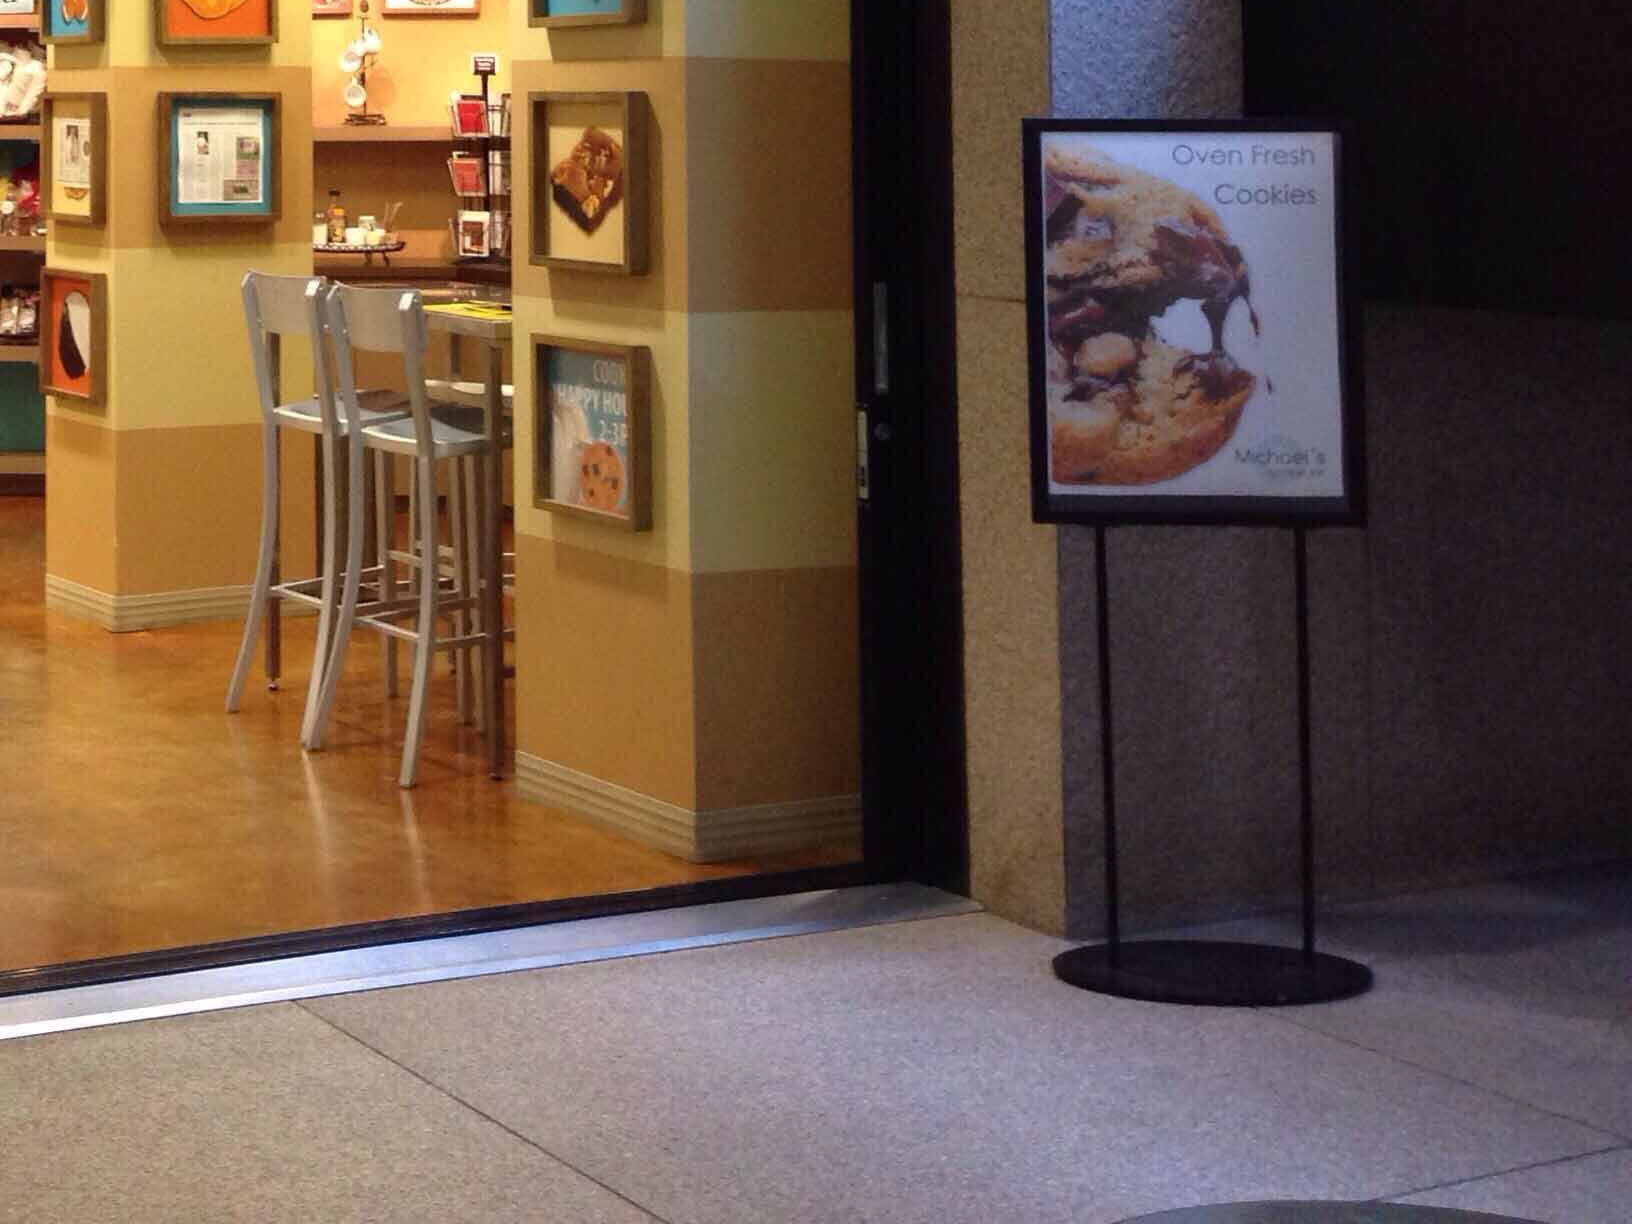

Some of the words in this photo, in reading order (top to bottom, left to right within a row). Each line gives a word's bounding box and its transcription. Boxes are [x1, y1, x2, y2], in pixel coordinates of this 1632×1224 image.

[1172, 144, 1243, 165] Oven
[1252, 144, 1315, 165] Fresh
[1214, 183, 1317, 205] Cookies
